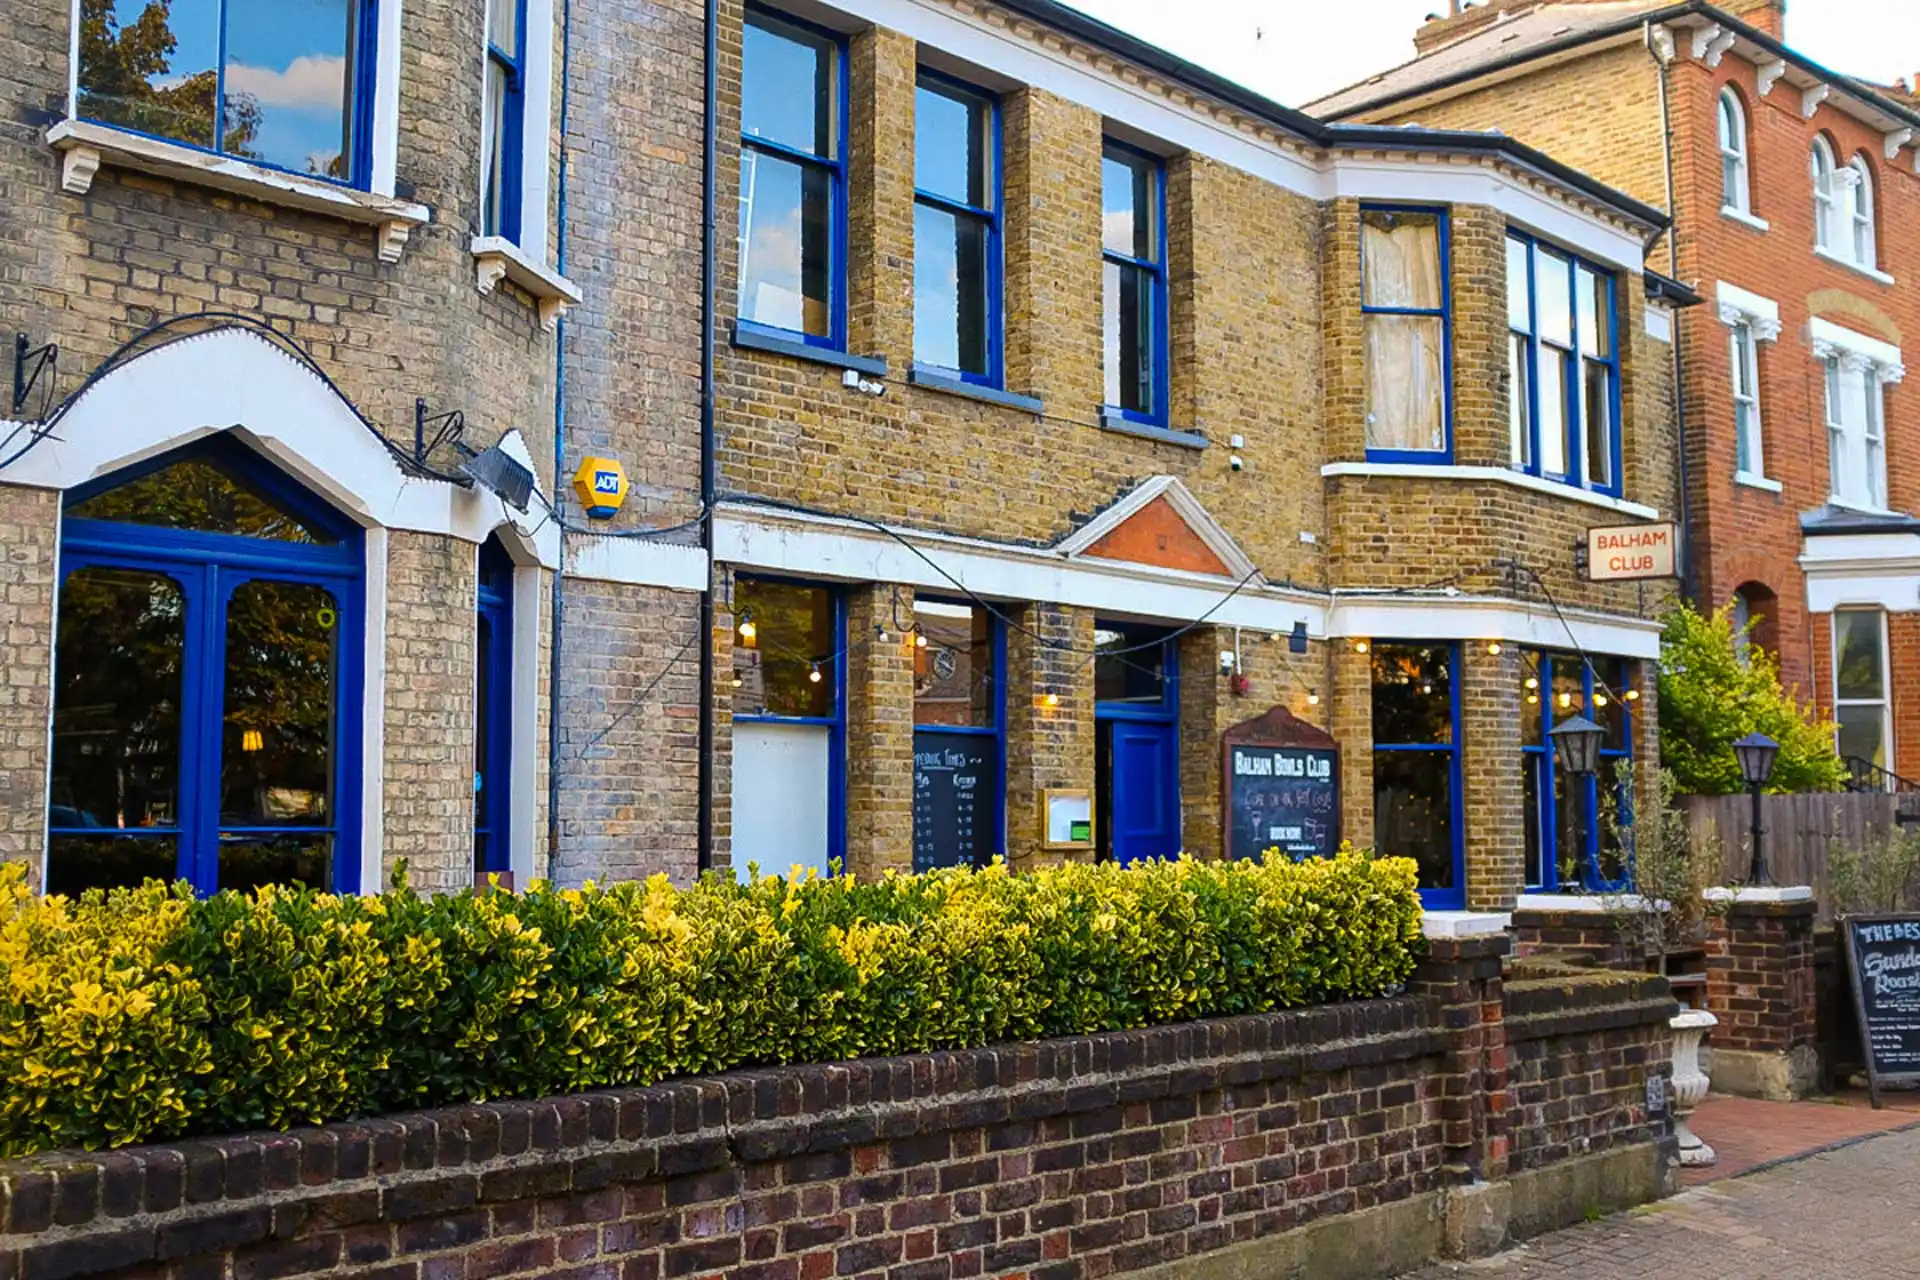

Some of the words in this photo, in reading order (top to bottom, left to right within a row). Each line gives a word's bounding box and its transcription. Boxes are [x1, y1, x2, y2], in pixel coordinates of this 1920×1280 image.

[595, 474, 618, 491] ADT
[1596, 531, 1667, 550] BALHAM
[1608, 555, 1654, 572] CLUB
[1234, 751, 1273, 776] BALHAM
[1306, 755, 1331, 778] CLUB
[1860, 925, 1894, 943] THE
